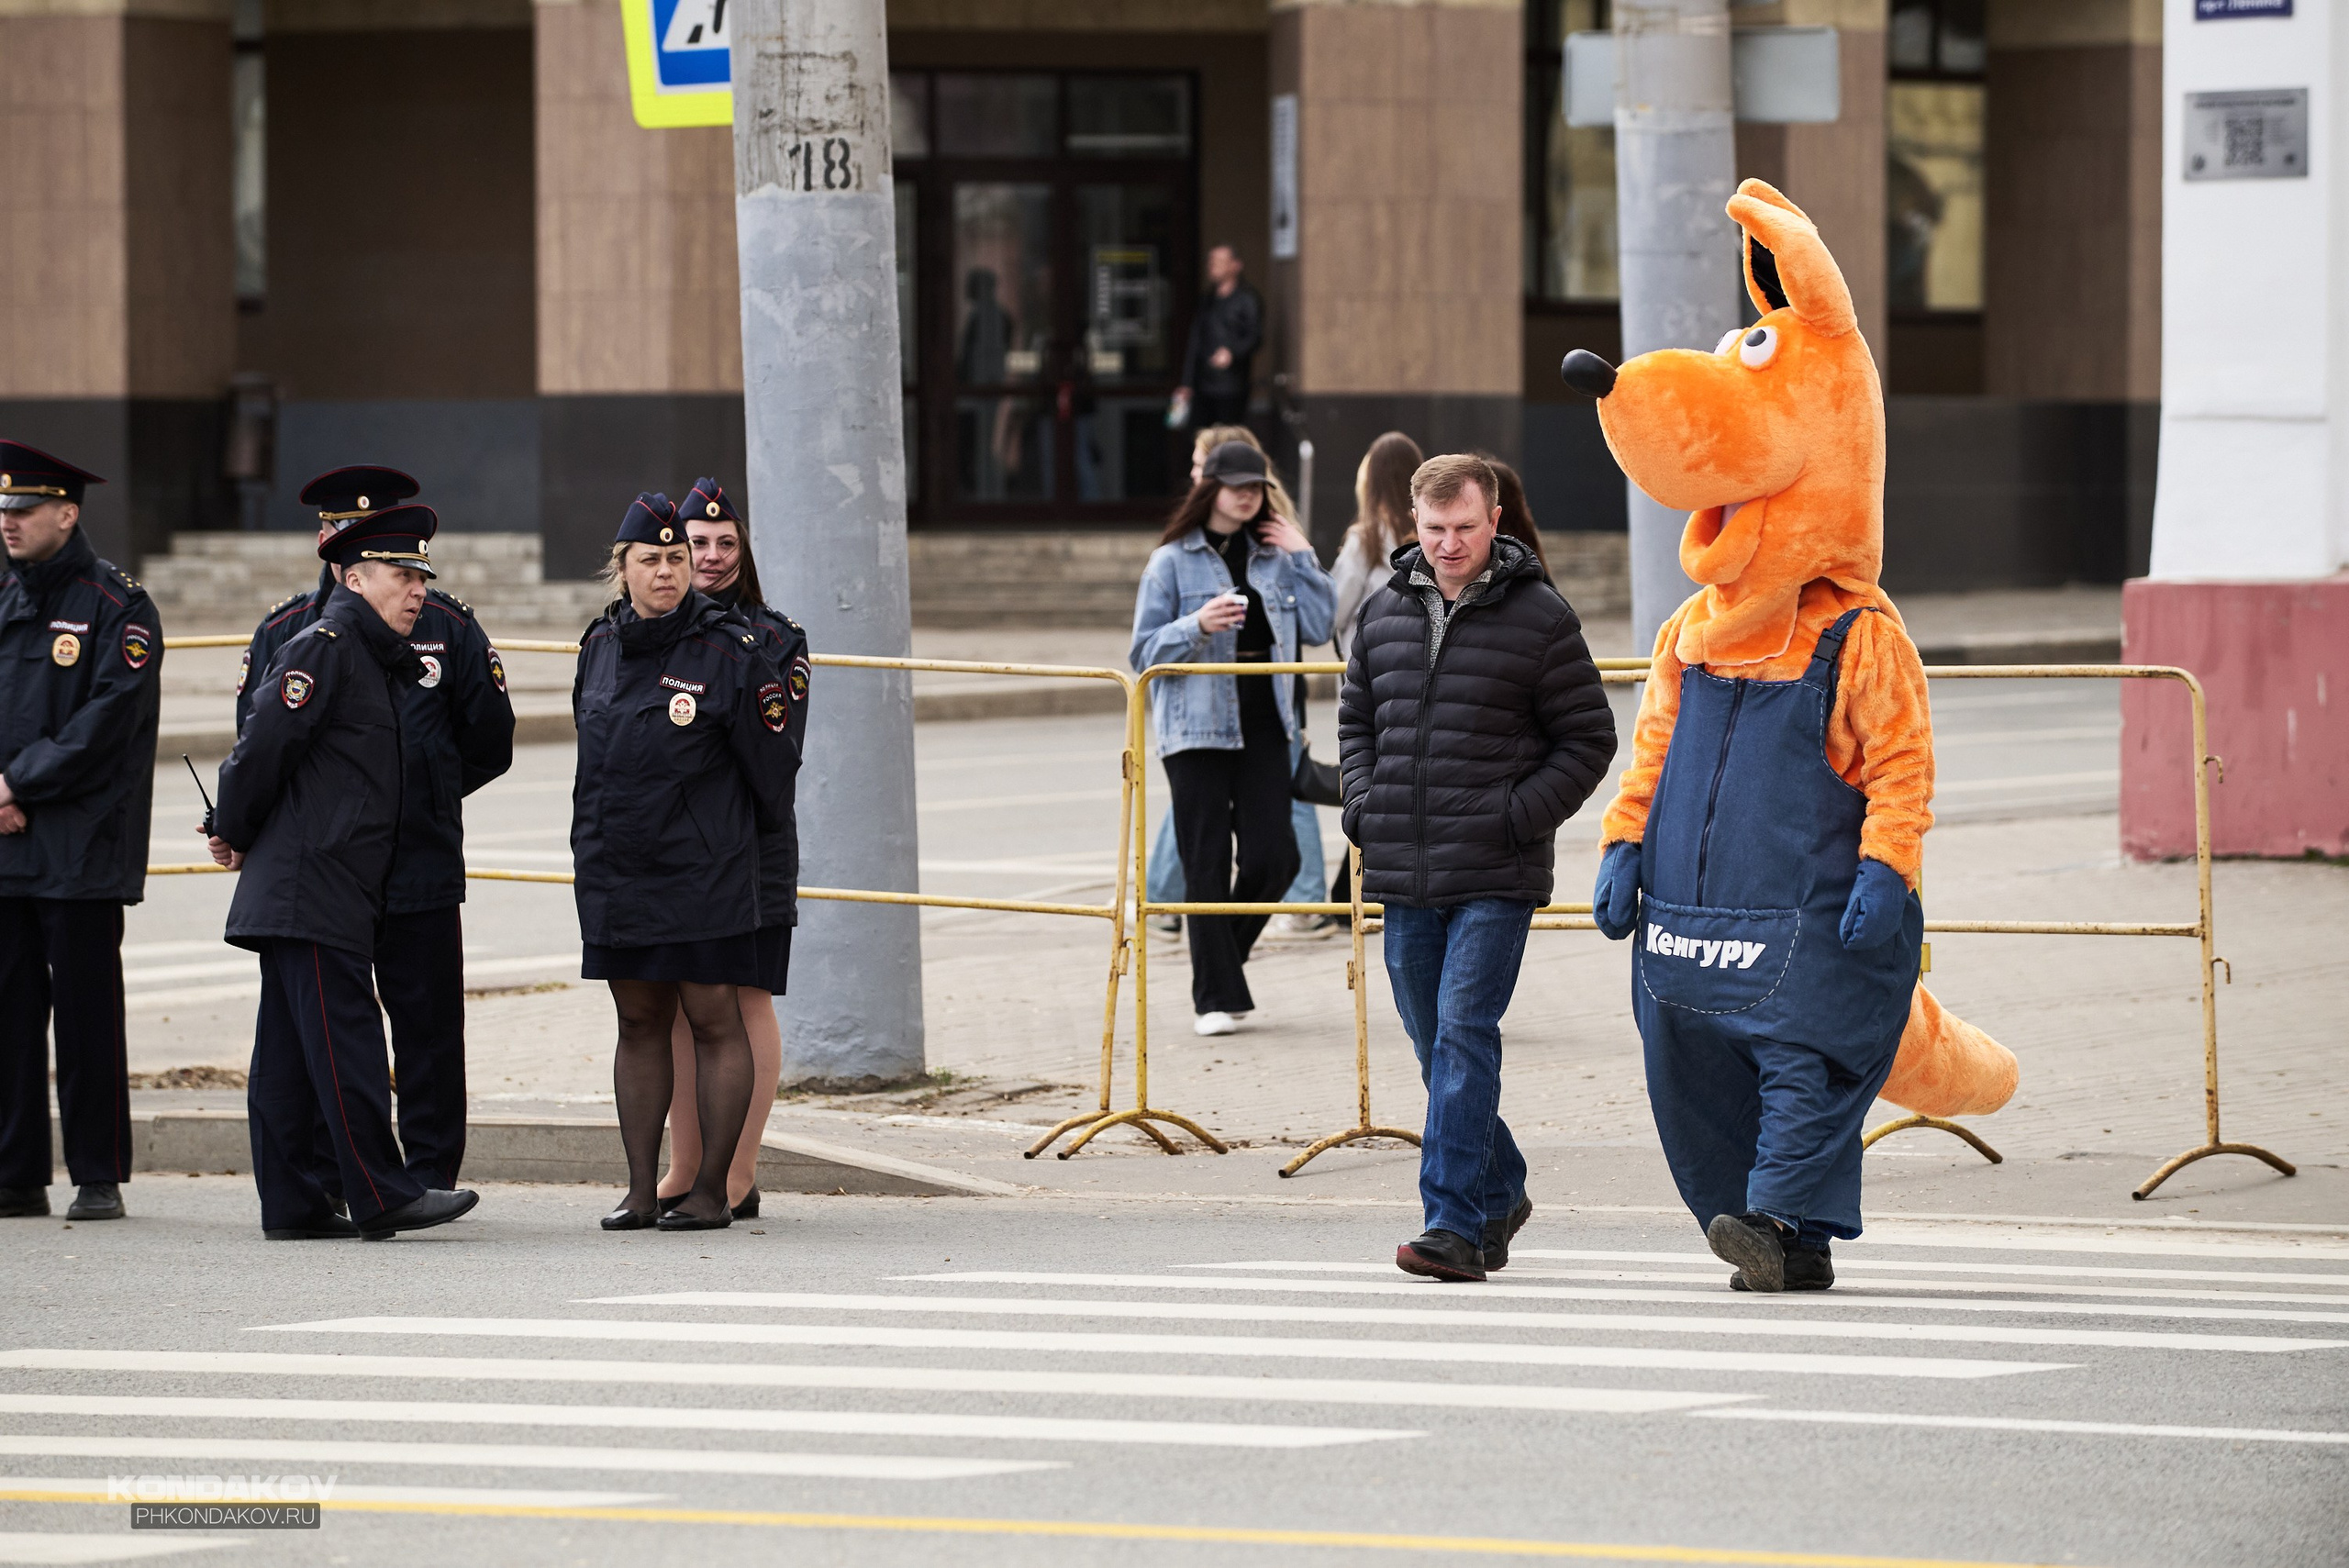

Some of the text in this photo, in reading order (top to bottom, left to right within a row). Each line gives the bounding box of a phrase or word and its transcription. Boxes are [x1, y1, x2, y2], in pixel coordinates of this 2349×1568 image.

[788, 138, 852, 191] 18
[50, 620, 89, 633] ПОЛИЦИЯ
[410, 642, 444, 651] ОЛИЦИЯ
[285, 670, 314, 684] ПОЛИЦИЯ
[662, 676, 704, 693] ПОЛИЦИЯ
[763, 693, 782, 704] РОССИЯ
[1646, 922, 1766, 970] Кенгуру
